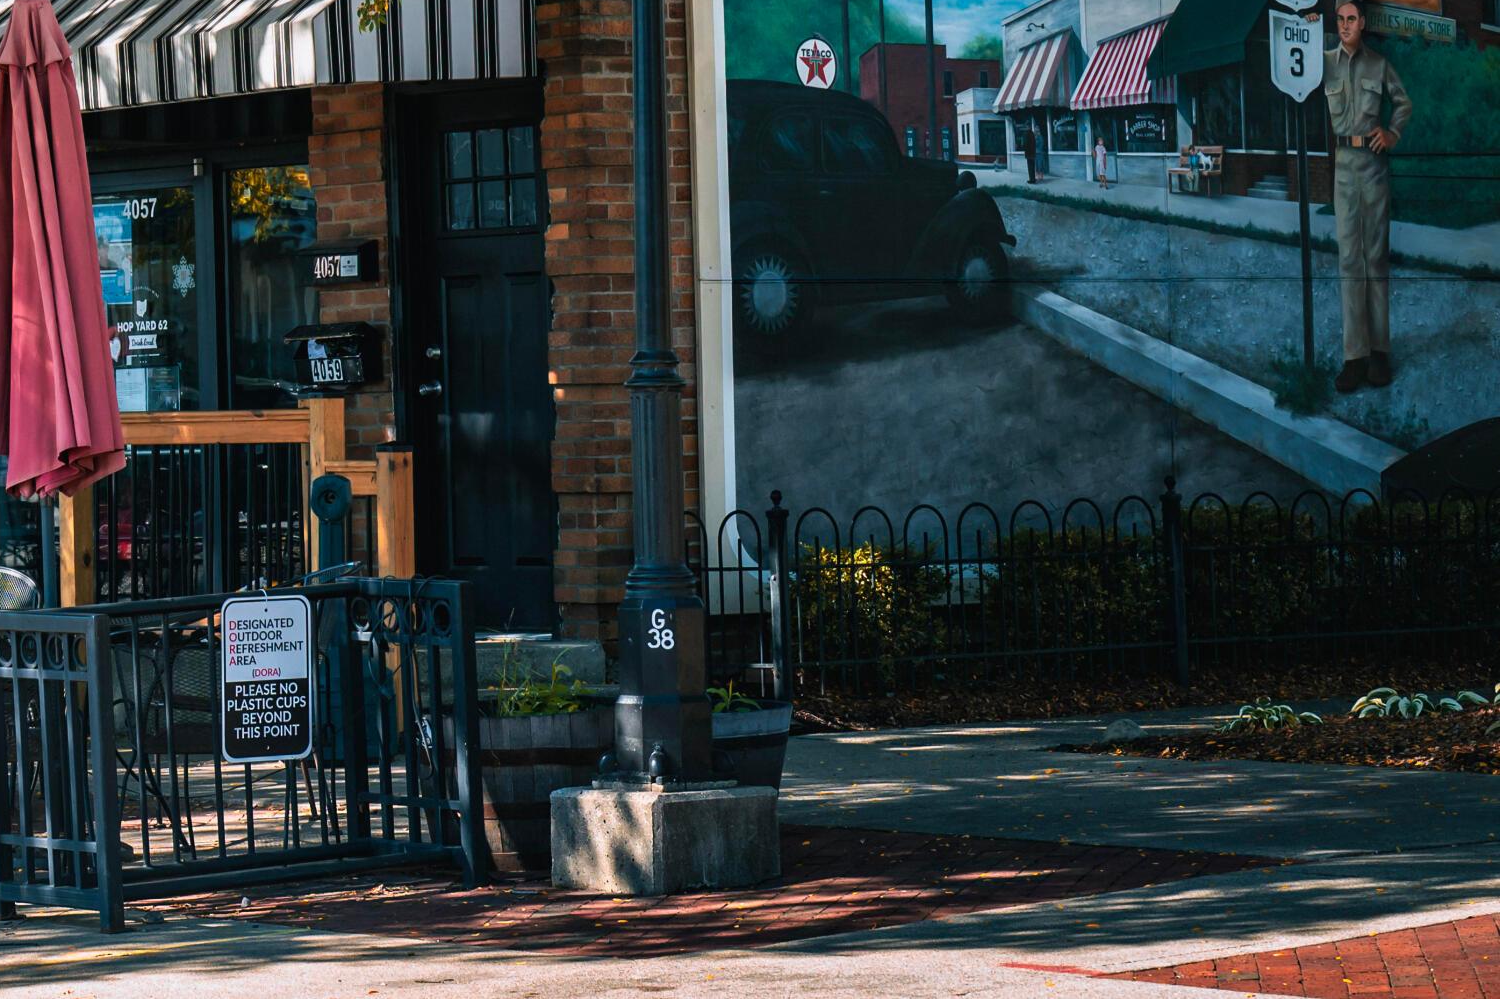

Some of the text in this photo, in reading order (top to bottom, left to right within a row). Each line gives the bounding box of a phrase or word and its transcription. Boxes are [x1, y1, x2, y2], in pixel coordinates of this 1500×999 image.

[1284, 26, 1310, 44] OHIO
[1404, 17, 1426, 33] DRUG
[1428, 21, 1452, 36] STORE
[801, 48, 832, 58] TEXACO
[1290, 47, 1305, 77] 3
[122, 197, 158, 220] 4057
[313, 254, 341, 279] 4057
[116, 319, 168, 333] HOP YARD 62
[312, 359, 343, 381] 4059
[229, 617, 294, 631] DESIGNATED
[651, 608, 666, 630] G
[229, 630, 283, 643] OUTDOOR
[647, 628, 675, 650] 38
[229, 640, 304, 655] REFRESHMENT
[229, 655, 257, 666] AREA
[252, 667, 282, 679] (DORA)
[235, 682, 298, 697] PLEASE NO
[227, 695, 307, 712] PLASTIC CUPS
[242, 710, 292, 725] BEYOND
[234, 723, 300, 740] THIS POINT
